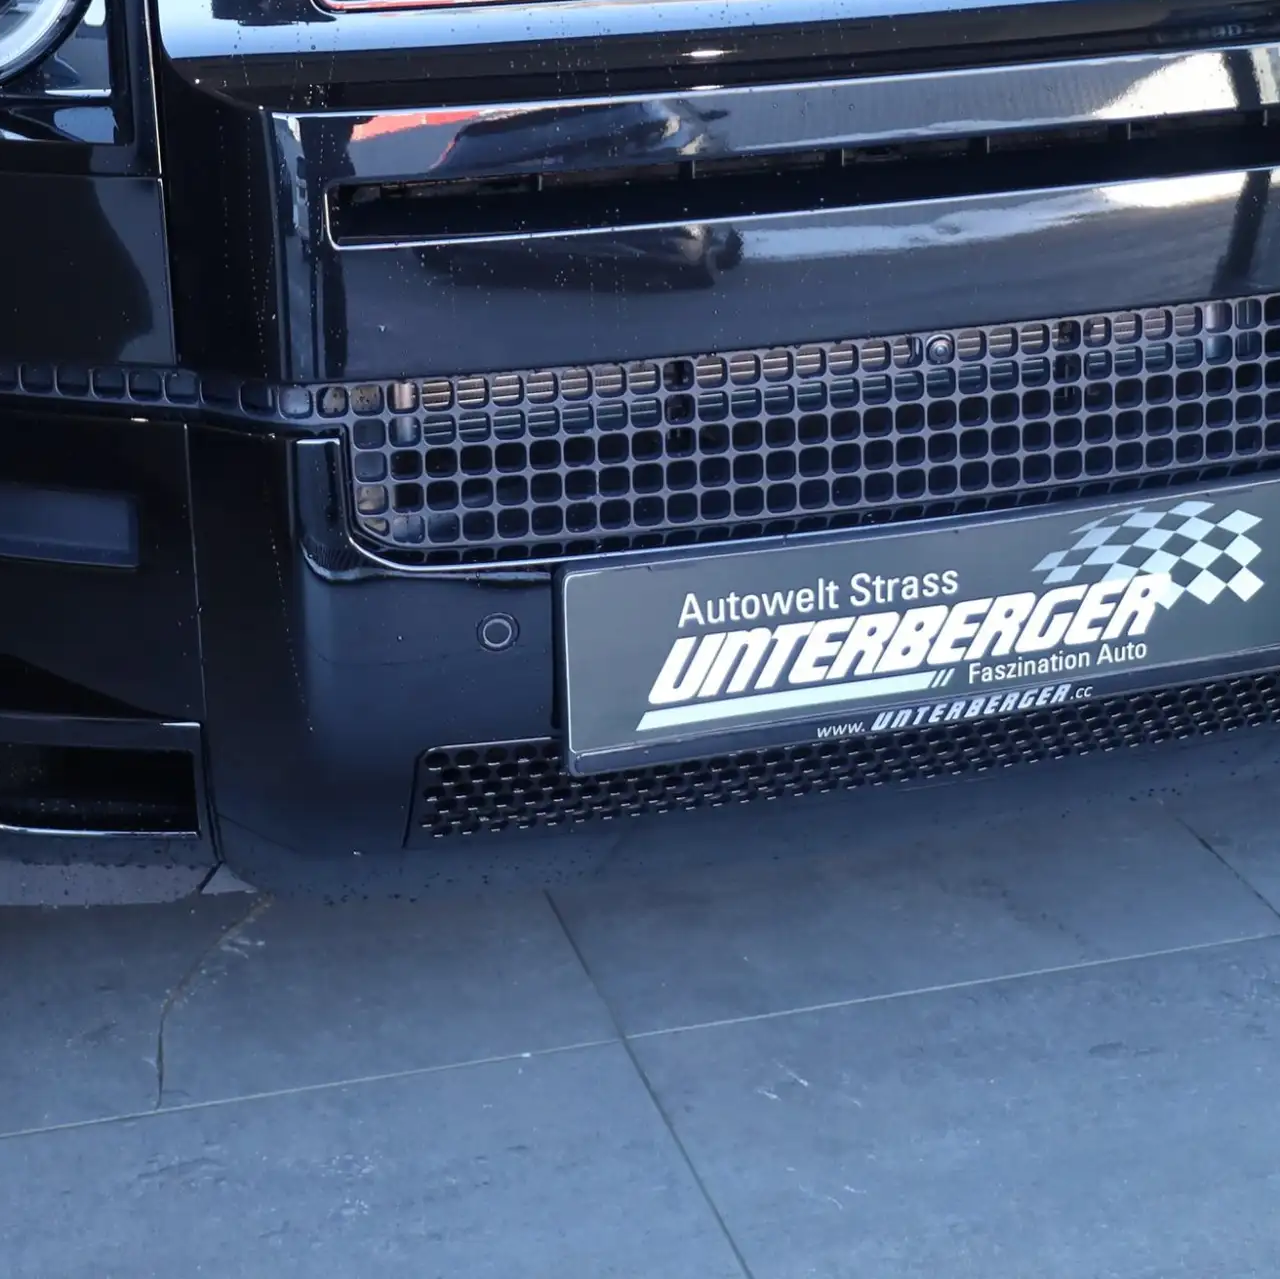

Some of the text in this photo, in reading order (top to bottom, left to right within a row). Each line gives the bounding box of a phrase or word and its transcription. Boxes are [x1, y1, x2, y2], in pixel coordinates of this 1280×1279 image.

[678, 570, 959, 628] Autowelt Strass
[648, 573, 1173, 704] UNTERBERGER
[969, 642, 1147, 684] Faszination Auto
